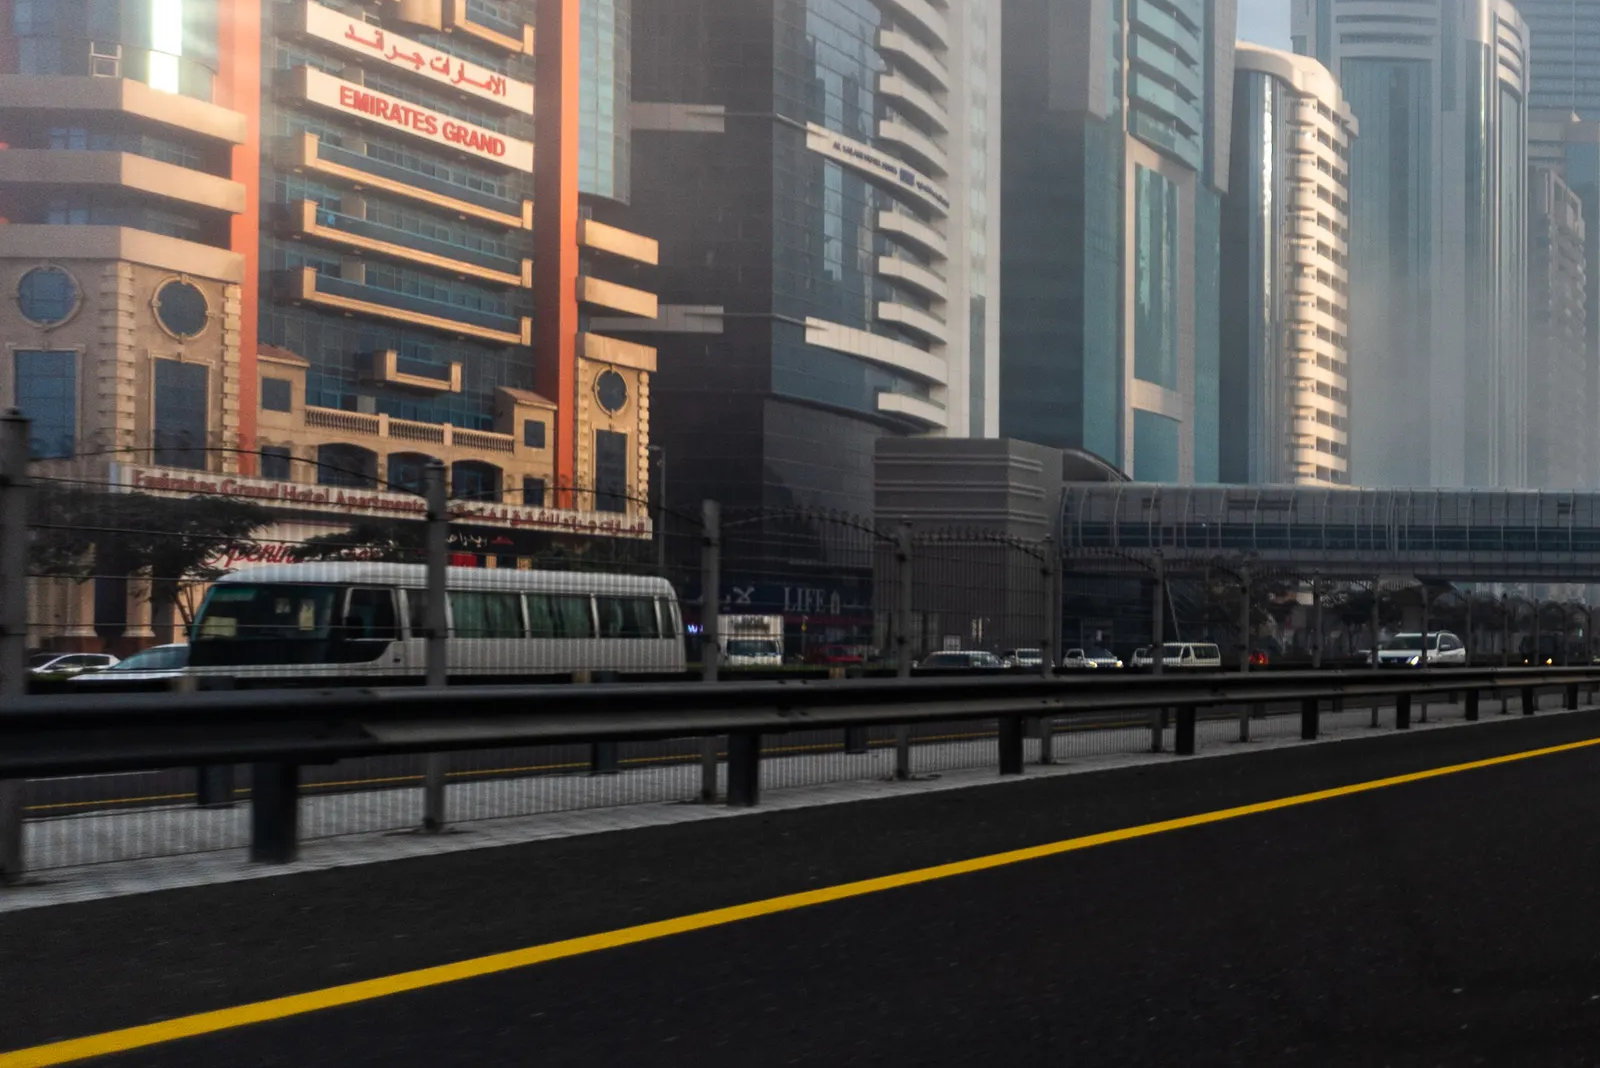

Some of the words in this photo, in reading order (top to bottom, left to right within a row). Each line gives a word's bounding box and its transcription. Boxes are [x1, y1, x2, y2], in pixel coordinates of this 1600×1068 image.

[340, 85, 438, 135] EMIRATES
[443, 121, 506, 157] GRAND
[132, 469, 217, 493] Emirates
[221, 479, 279, 499] Grand
[283, 485, 330, 504] Hotel
[336, 490, 426, 512] Apartments
[782, 586, 826, 613] LIFE
